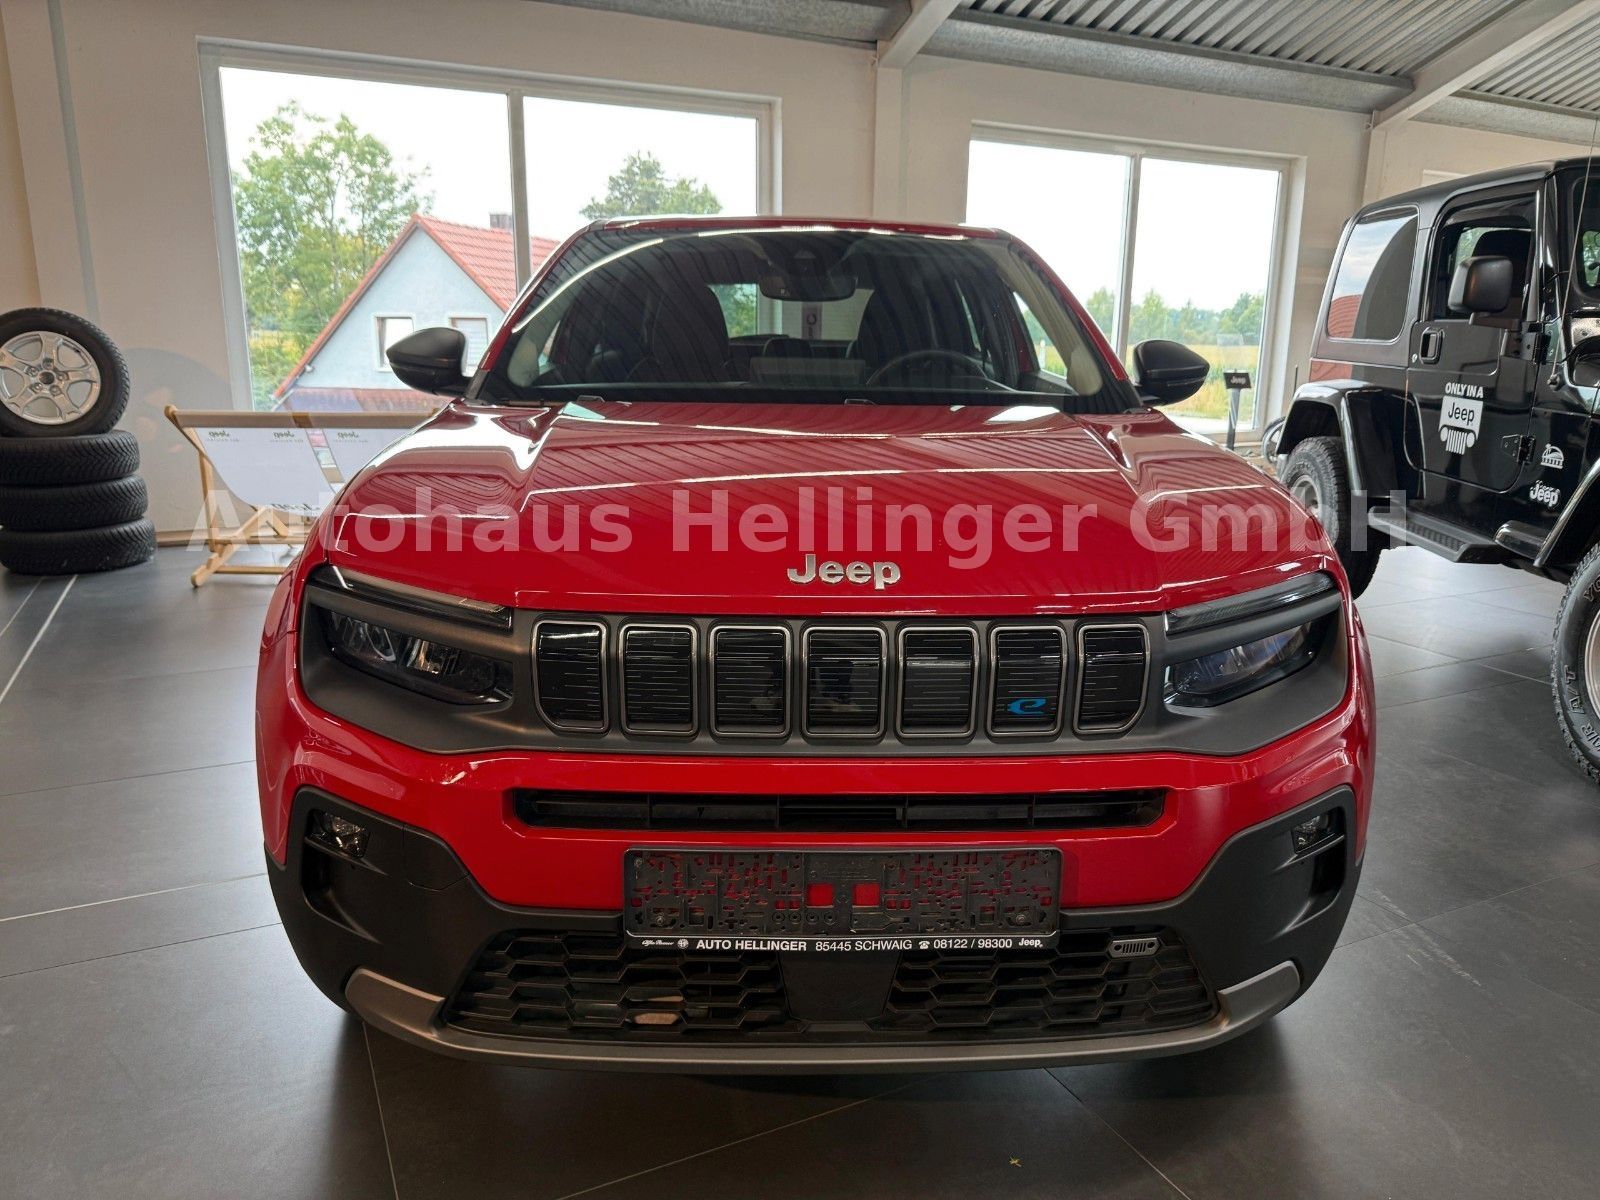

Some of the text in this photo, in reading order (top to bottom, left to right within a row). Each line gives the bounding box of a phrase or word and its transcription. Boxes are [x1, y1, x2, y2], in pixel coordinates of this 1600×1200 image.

[1445, 382, 1484, 399] ONLY IN A
[1448, 402, 1475, 426] Jeep
[1529, 480, 1561, 508] Jeep
[787, 553, 901, 590] Jeep
[696, 939, 732, 950] AUTO
[735, 940, 807, 951] HELLINGER
[815, 941, 851, 952] 85445
[855, 940, 912, 951] SCHWAIG
[933, 938, 968, 949] 08122
[978, 938, 1013, 949] 98300
[1018, 937, 1042, 947] Jeep
